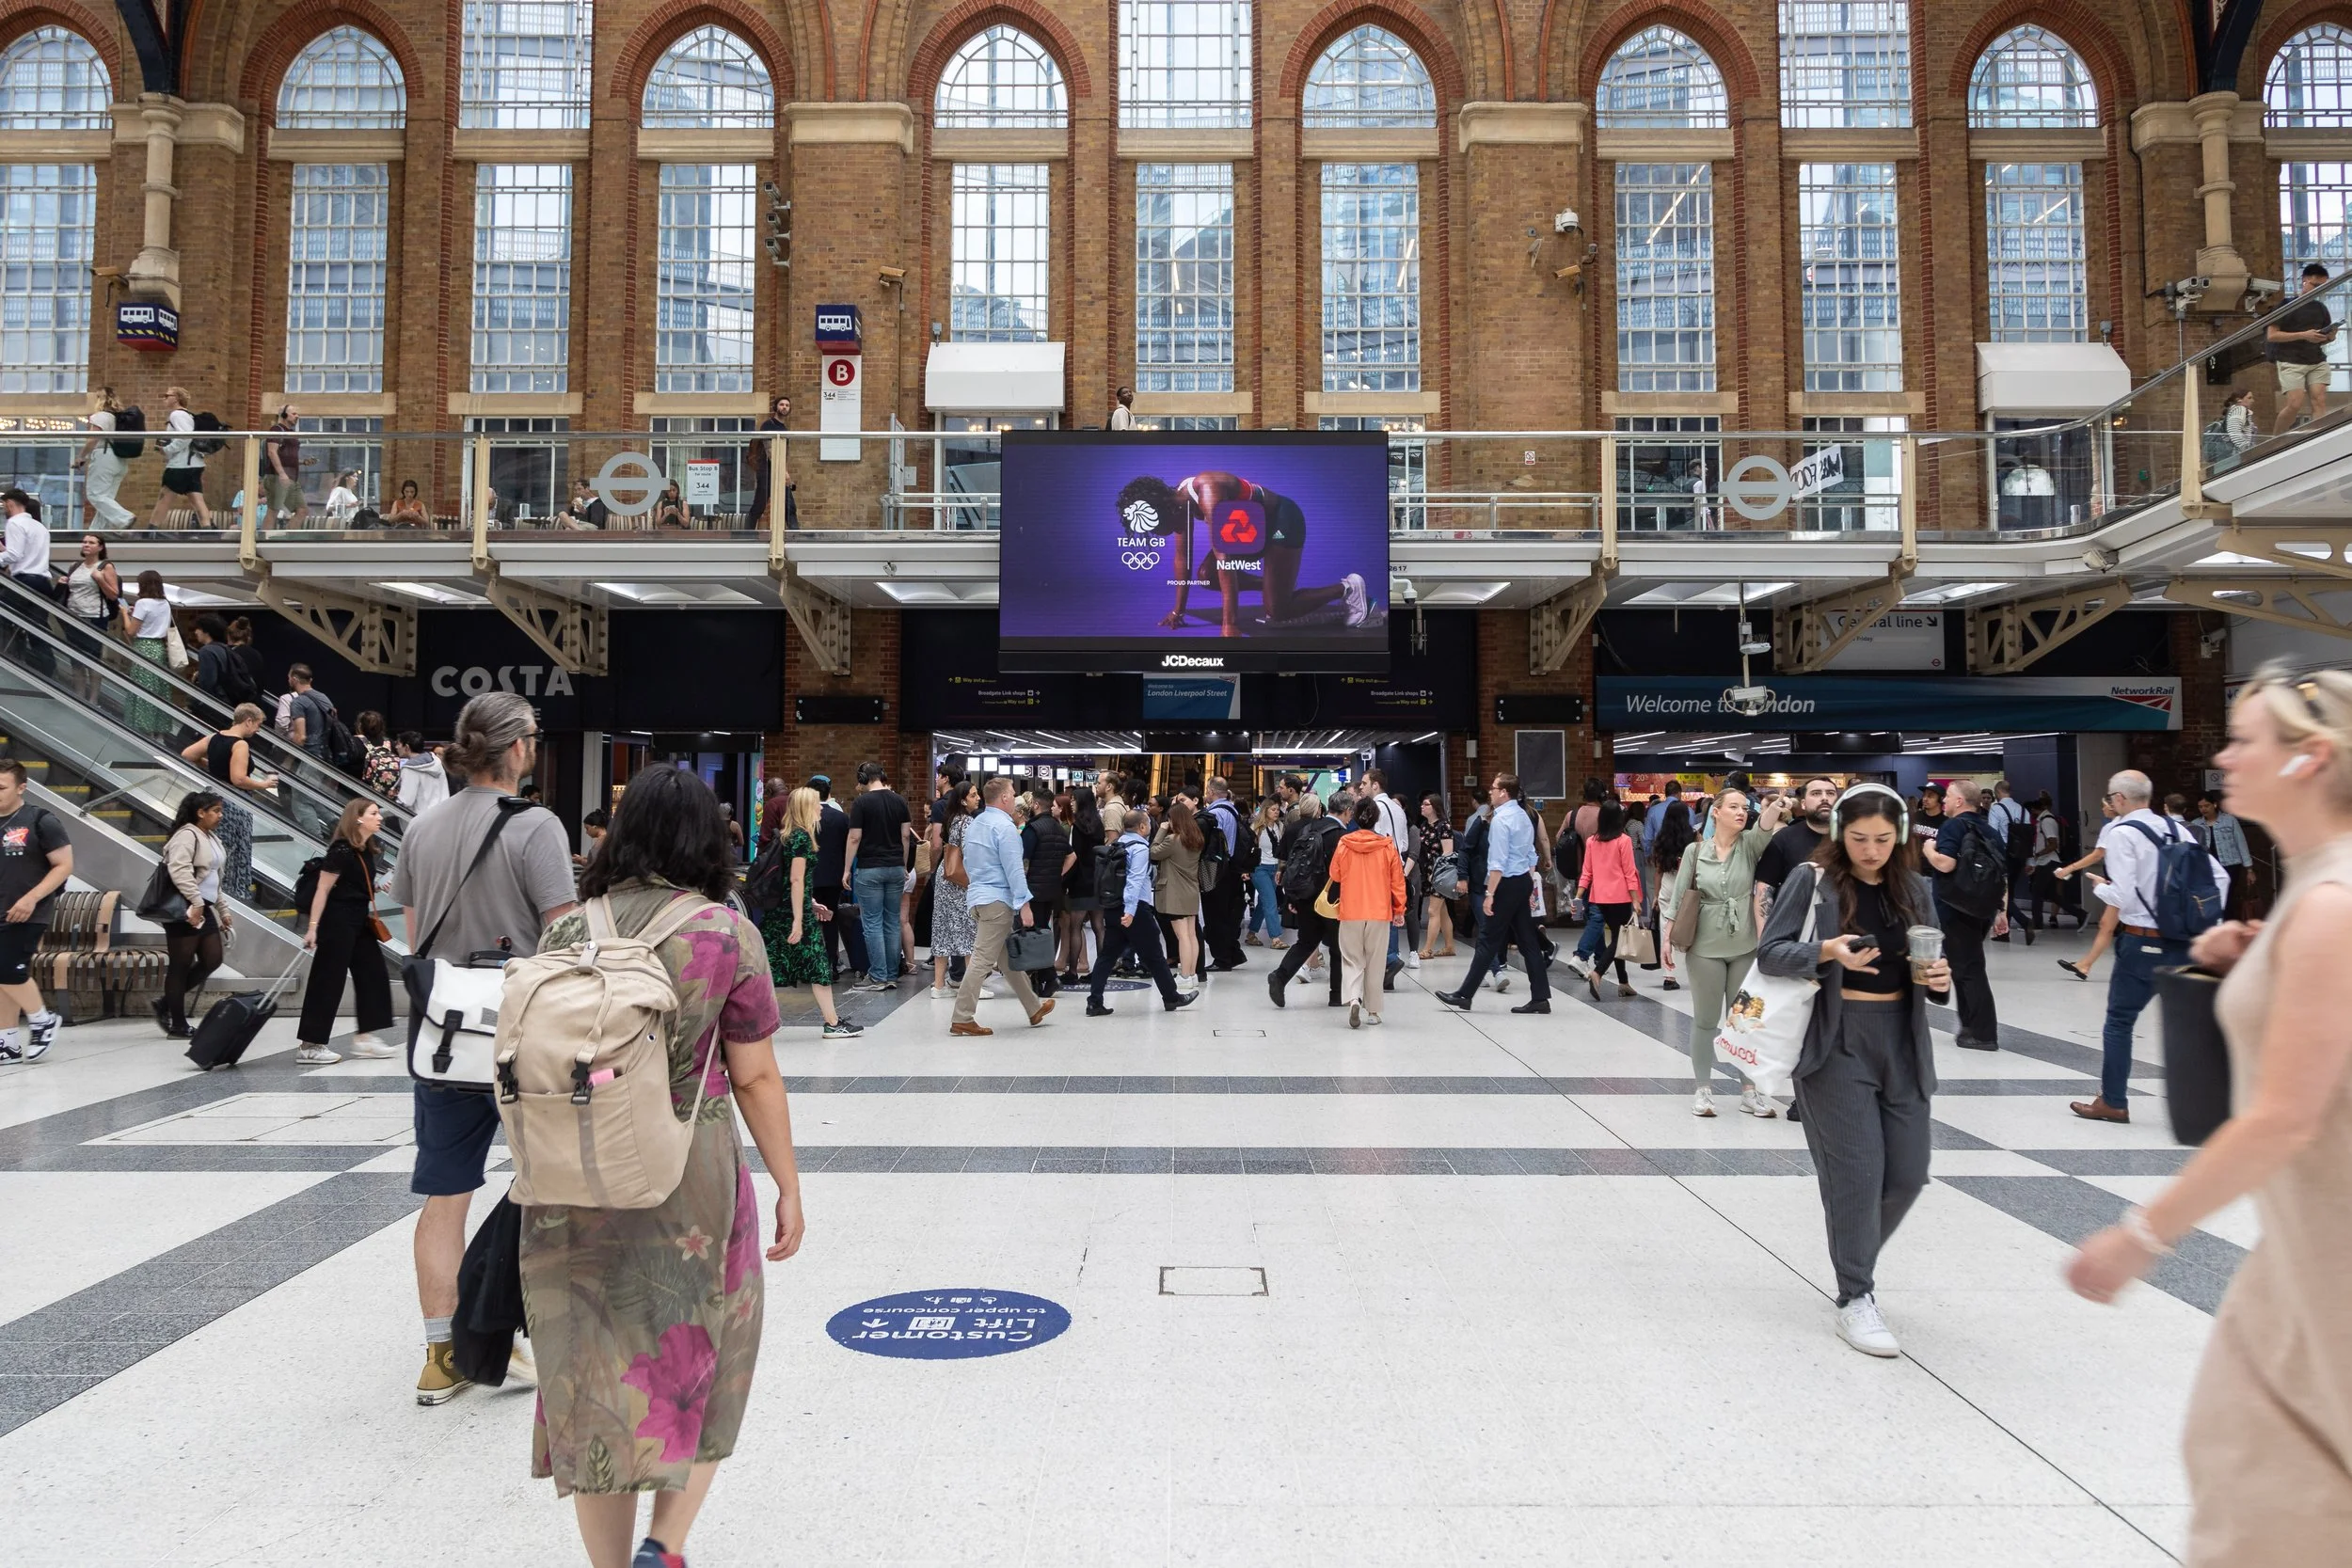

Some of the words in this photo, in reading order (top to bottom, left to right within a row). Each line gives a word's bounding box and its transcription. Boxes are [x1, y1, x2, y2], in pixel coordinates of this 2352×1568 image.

[836, 364, 849, 382] B
[1117, 537, 1147, 547] TEAM
[1150, 537, 1166, 547] GB
[1216, 560, 1262, 571] NatWest
[1897, 614, 1923, 628] line
[1162, 655, 1224, 668] JCDecaux
[431, 665, 575, 698] COSTA
[1174, 689, 1206, 698] Liverpool
[2111, 687, 2175, 695] NetworkRail
[1627, 694, 1710, 713] Welcome
[1717, 696, 1736, 713] to
[1742, 694, 1816, 713] ndon
[974, 1318, 1035, 1329] Lift
[851, 1330, 1034, 1342] Customer
